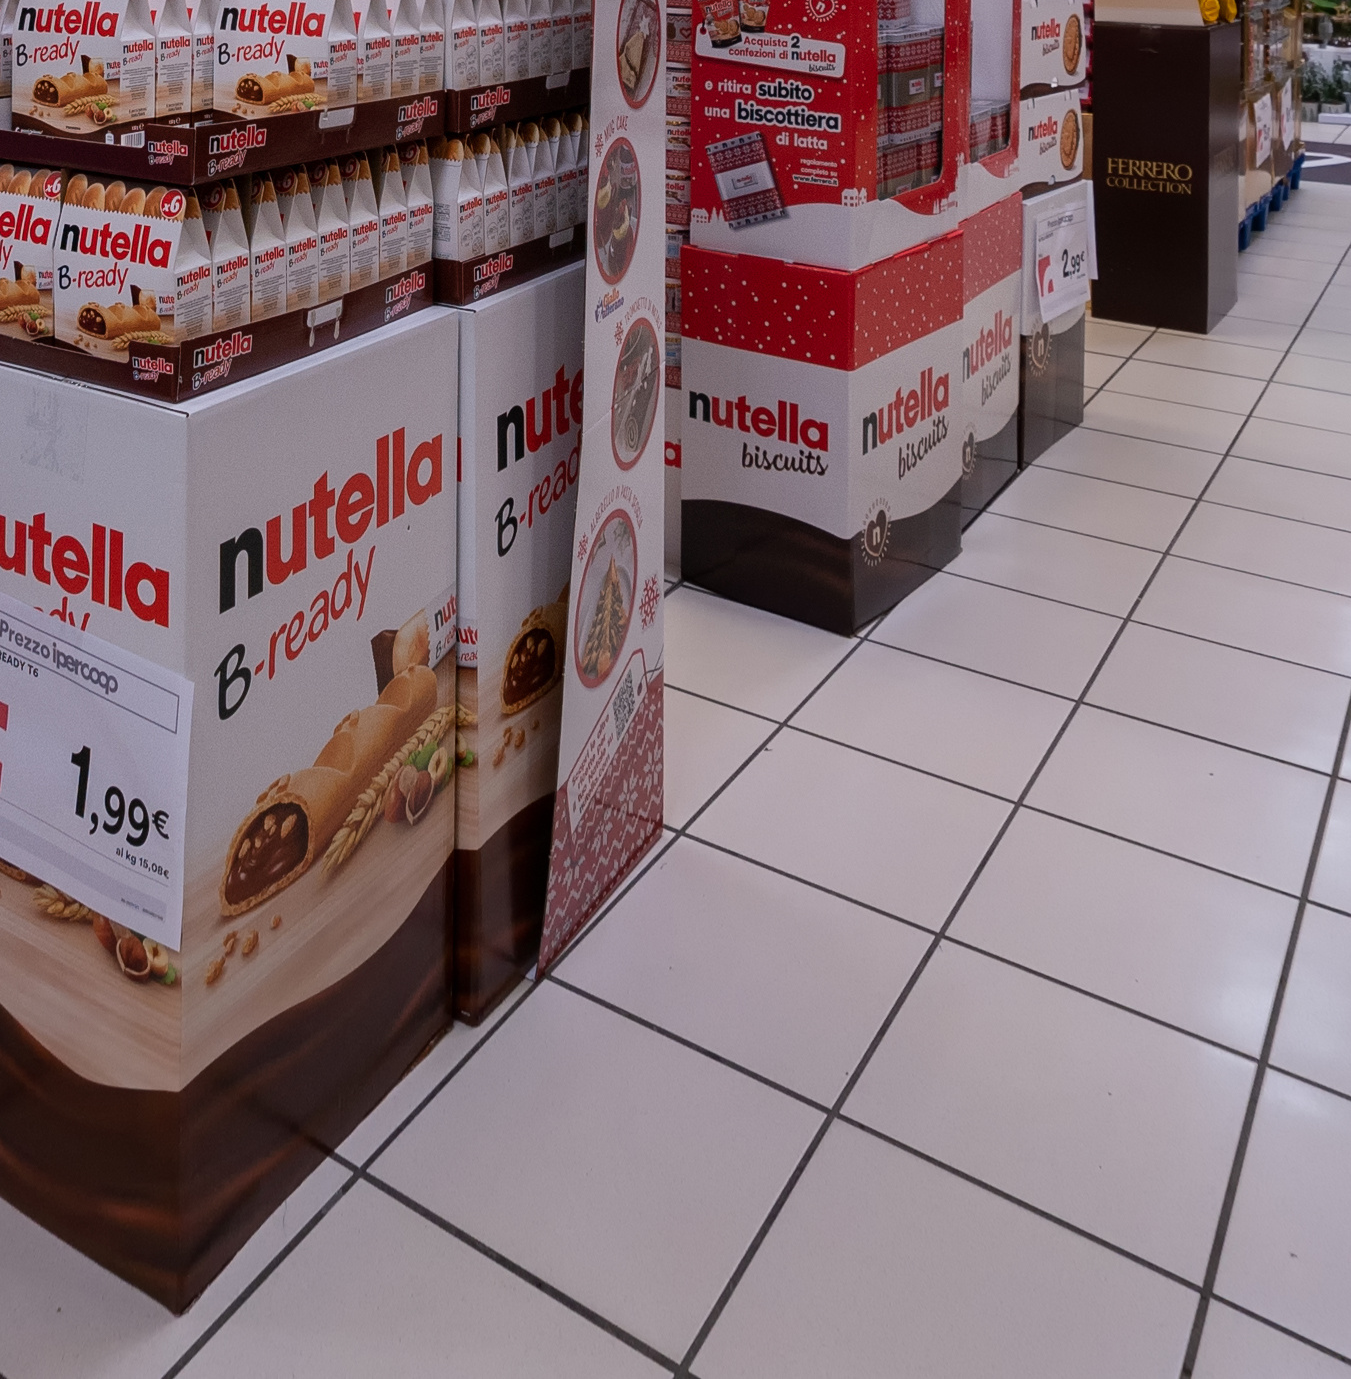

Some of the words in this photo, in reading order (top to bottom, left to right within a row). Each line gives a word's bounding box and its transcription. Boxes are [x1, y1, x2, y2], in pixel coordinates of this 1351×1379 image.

[743, 36, 788, 49] Acquista
[791, 36, 800, 48] 2
[1031, 18, 1061, 42] nutella
[728, 48, 775, 60] confezioni
[779, 49, 788, 60] di
[791, 49, 836, 64] nutella
[808, 63, 836, 72] biscuits
[705, 80, 713, 90] e
[718, 80, 751, 94] ritira
[758, 80, 812, 102] subito
[399, 97, 438, 121] nutella
[704, 106, 730, 118] una
[737, 102, 839, 130] biscottiera
[776, 133, 790, 146] di
[794, 134, 828, 150] latta
[1107, 158, 1192, 182] FERRERO
[1106, 176, 1192, 194] COLLECTION
[1061, 248, 1085, 278] 2,99€
[193, 332, 253, 368] nutella
[689, 390, 829, 452] nutella
[862, 366, 949, 455] nutella
[742, 442, 829, 475] biscuits
[898, 414, 948, 480] biscuits
[219, 426, 443, 615] nutella
[214, 546, 376, 722] B-ready
[0, 619, 50, 660] Prezzo
[51, 645, 119, 695] ipercoop
[25, 662, 39, 678] T6
[70, 745, 170, 847] 1,99€
[115, 846, 124, 858] al
[124, 851, 137, 866] kg
[138, 857, 170, 880] 15,08€
